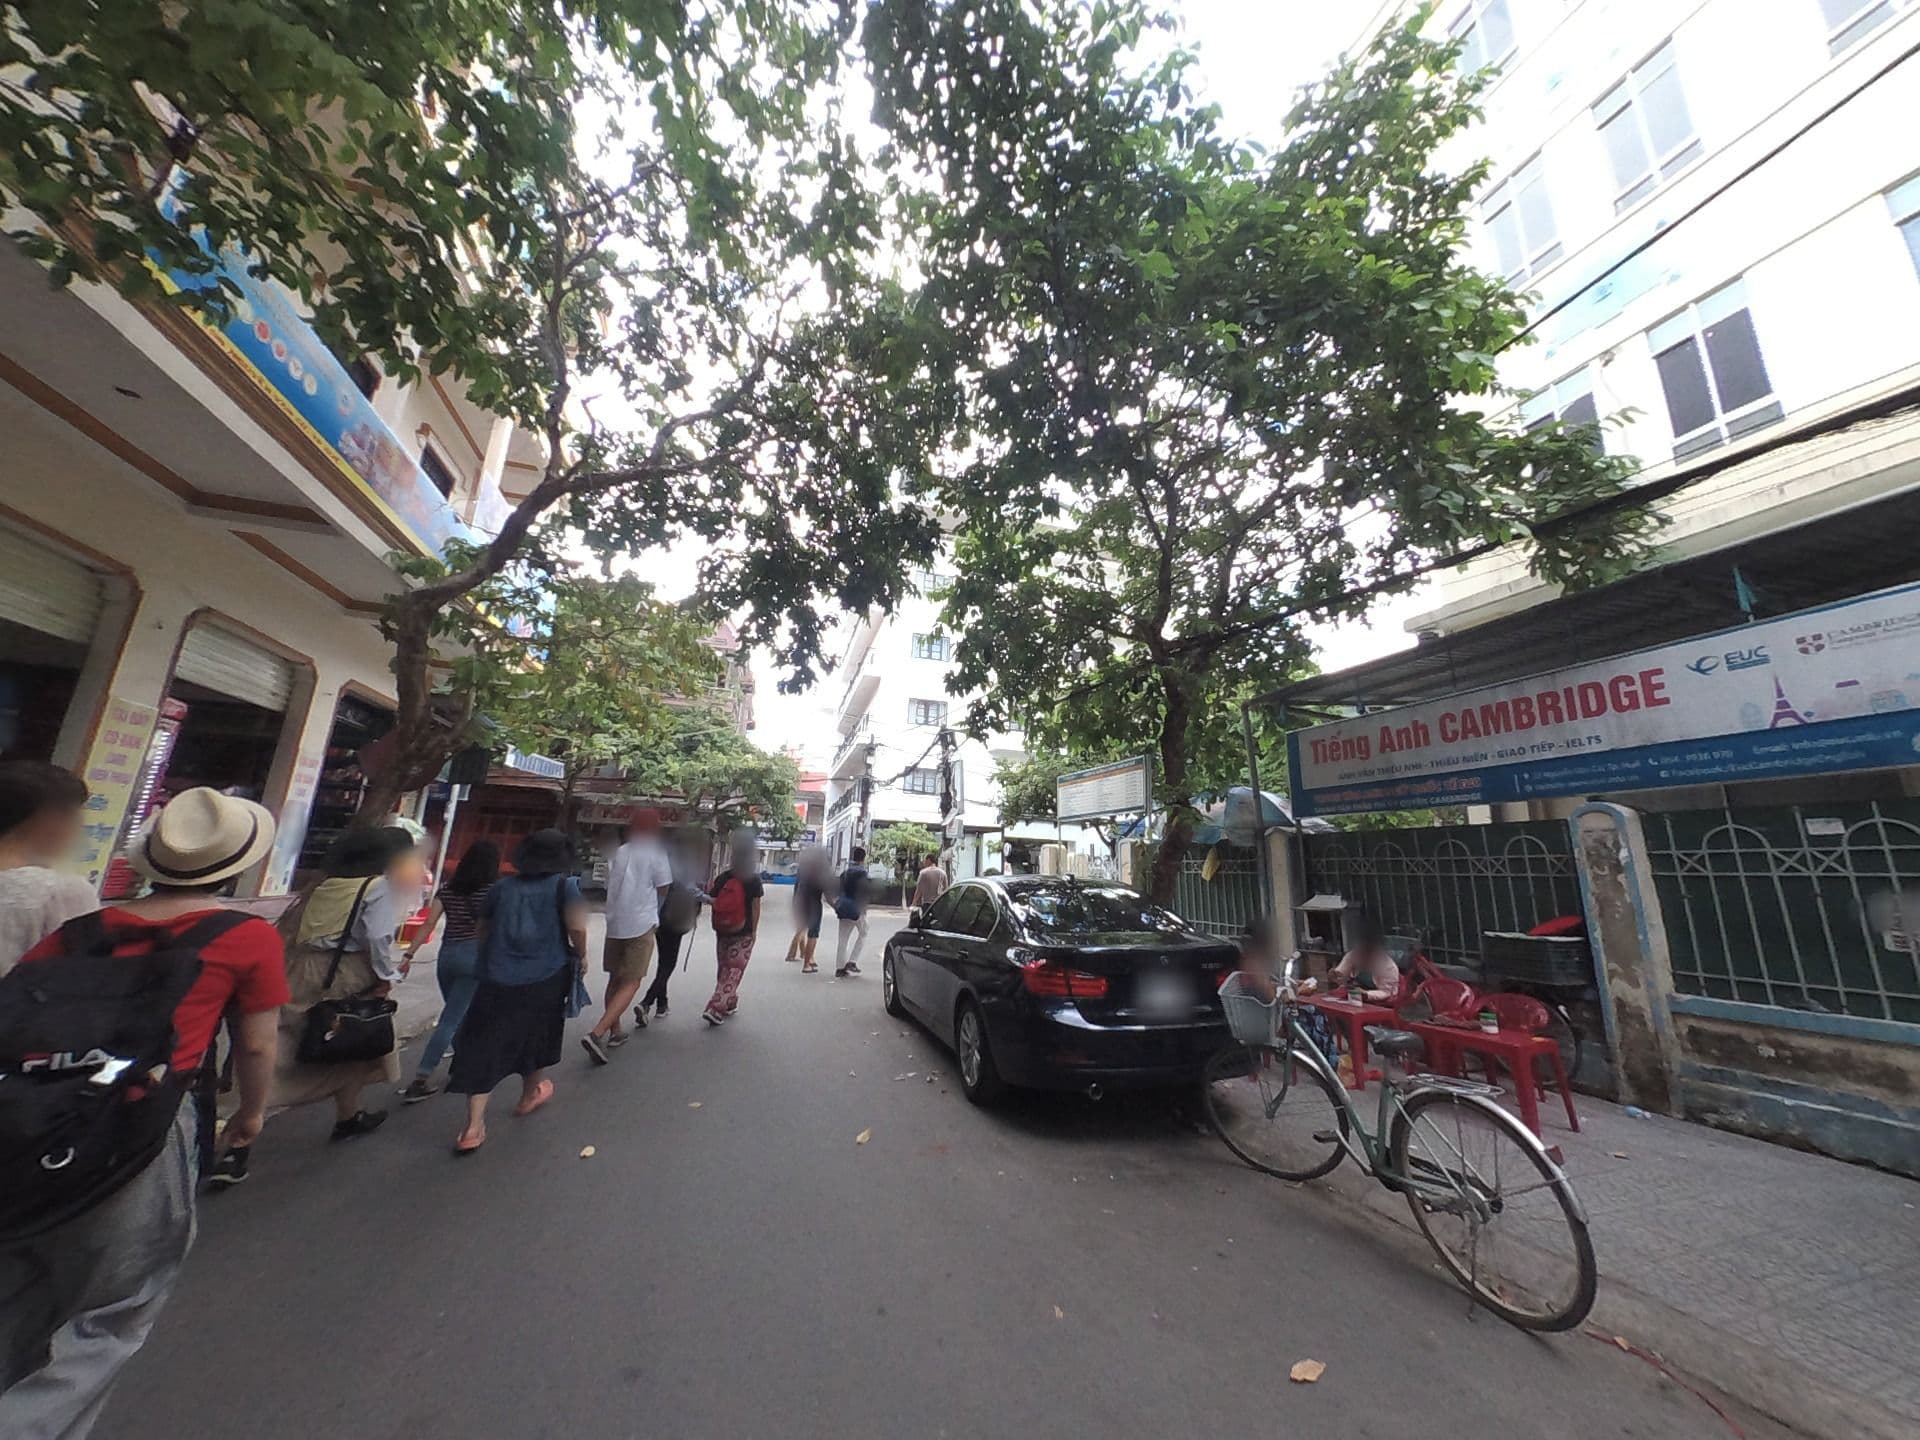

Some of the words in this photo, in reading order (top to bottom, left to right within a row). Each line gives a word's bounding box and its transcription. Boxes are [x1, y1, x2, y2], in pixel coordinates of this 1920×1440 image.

[1724, 645, 1770, 665] EUC
[1310, 730, 1370, 765] Tiếng
[1379, 720, 1431, 754] Anh
[1438, 668, 1671, 745] CAMBRIDGE
[1497, 746, 1527, 759] GIAO
[1529, 740, 1556, 755] TIẾP
[1565, 734, 1603, 749] IELTS
[21, 1047, 115, 1073] FILA
